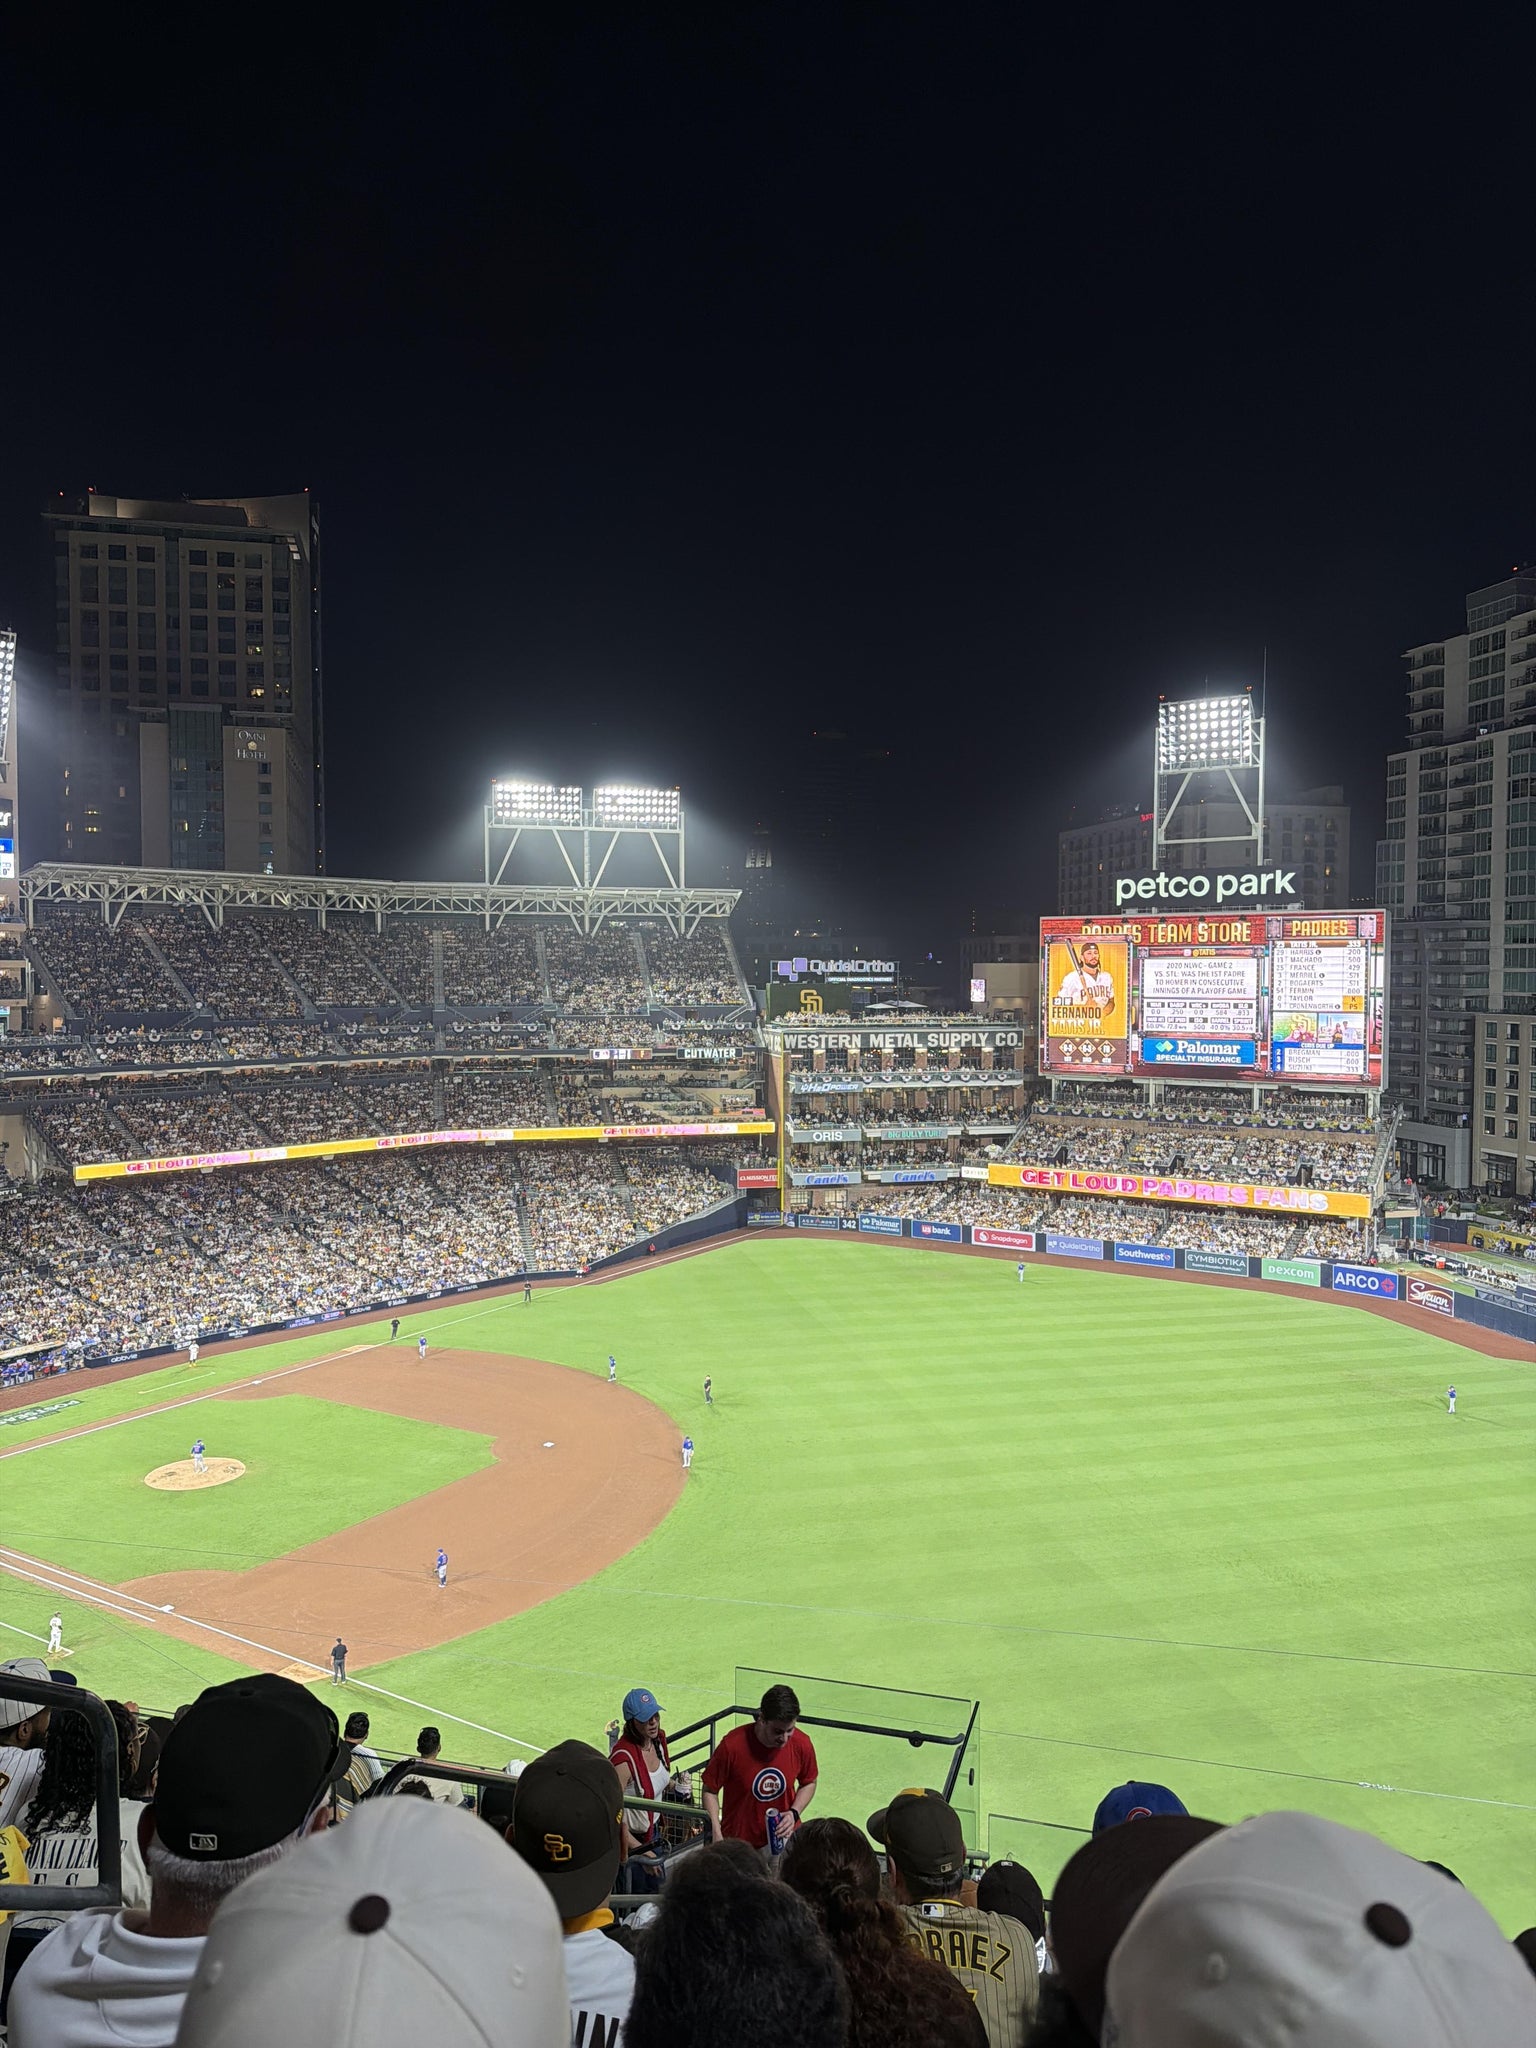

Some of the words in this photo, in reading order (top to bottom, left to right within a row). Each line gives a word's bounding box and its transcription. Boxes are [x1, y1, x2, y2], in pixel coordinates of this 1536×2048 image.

[237, 749, 266, 760] HOTEL
[1116, 871, 1210, 907] petco
[1216, 869, 1296, 904] park
[1147, 923, 1192, 943] TEAM
[1197, 922, 1251, 943] STORE
[1292, 919, 1349, 937] PADRES
[810, 959, 895, 975] QuidelOrtho
[1052, 1007, 1102, 1019] FERNANDO
[1052, 1019, 1086, 1034] TATIS
[1087, 1019, 1105, 1035] JR.
[784, 1033, 861, 1050] WESTERN
[870, 1033, 922, 1048] METAL
[928, 1032, 989, 1047] SUPPLY
[995, 1032, 1022, 1047] CO.
[1176, 1040, 1241, 1055] Palomar
[684, 1048, 736, 1058] CUTWATER
[1156, 1054, 1196, 1062] SPECIALTY
[1198, 1055, 1242, 1064] INSURANCE
[812, 1131, 842, 1142] ORIS
[127, 1162, 152, 1172] GET
[157, 1158, 194, 1170] LOUD
[1020, 1169, 1066, 1186] GET
[1071, 1172, 1138, 1192] LOUD
[1142, 1178, 1248, 1204] PADRES
[1254, 1188, 1330, 1212] FANS
[842, 1220, 856, 1229] 342
[871, 1218, 900, 1228] Palomar
[932, 1226, 952, 1236] bank
[990, 1233, 1028, 1245] Snapdragon
[1059, 1241, 1100, 1253] QuidelOrtho
[1118, 1247, 1164, 1262] Southwest
[1188, 1254, 1246, 1267] CYMBIOTIKA
[1335, 1272, 1379, 1290] ARCO
[1410, 1282, 1449, 1307] Sycuan
[111, 1353, 138, 1364] abbvie
[543, 1833, 572, 1861] SD
